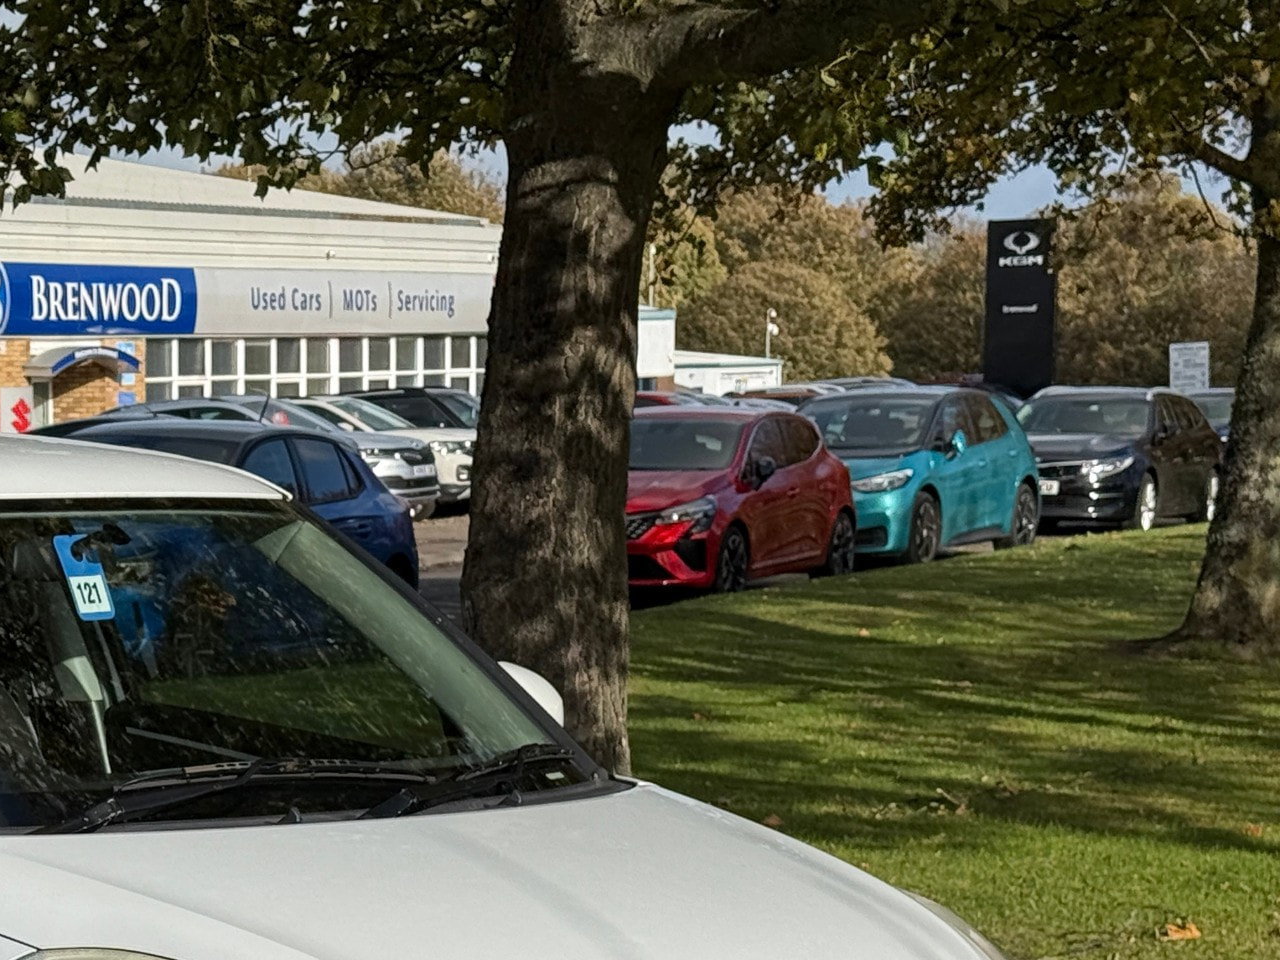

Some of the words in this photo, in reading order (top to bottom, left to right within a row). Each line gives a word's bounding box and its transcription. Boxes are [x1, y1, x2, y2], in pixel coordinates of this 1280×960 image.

[31, 275, 182, 322] BRENWOOD
[250, 287, 286, 310] Used
[291, 289, 321, 312] Cars
[342, 289, 377, 312] MOTs
[397, 289, 455, 318] Servicing
[76, 582, 102, 604] 121
